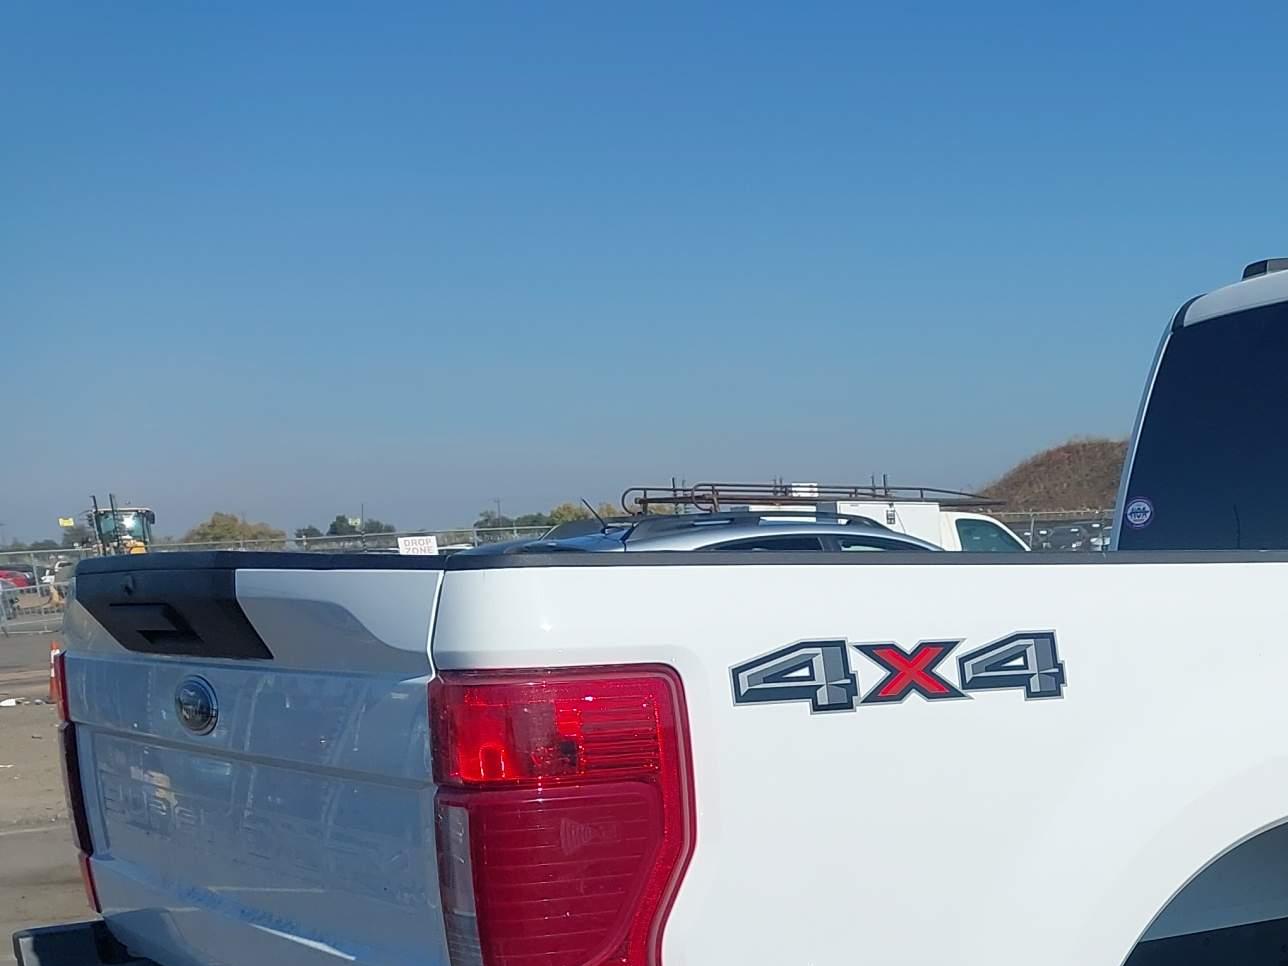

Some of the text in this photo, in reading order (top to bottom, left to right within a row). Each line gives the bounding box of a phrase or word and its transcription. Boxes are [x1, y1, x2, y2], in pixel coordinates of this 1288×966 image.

[403, 538, 432, 547] DROP
[404, 546, 433, 554] ZONE
[728, 629, 1067, 715] 4X4
